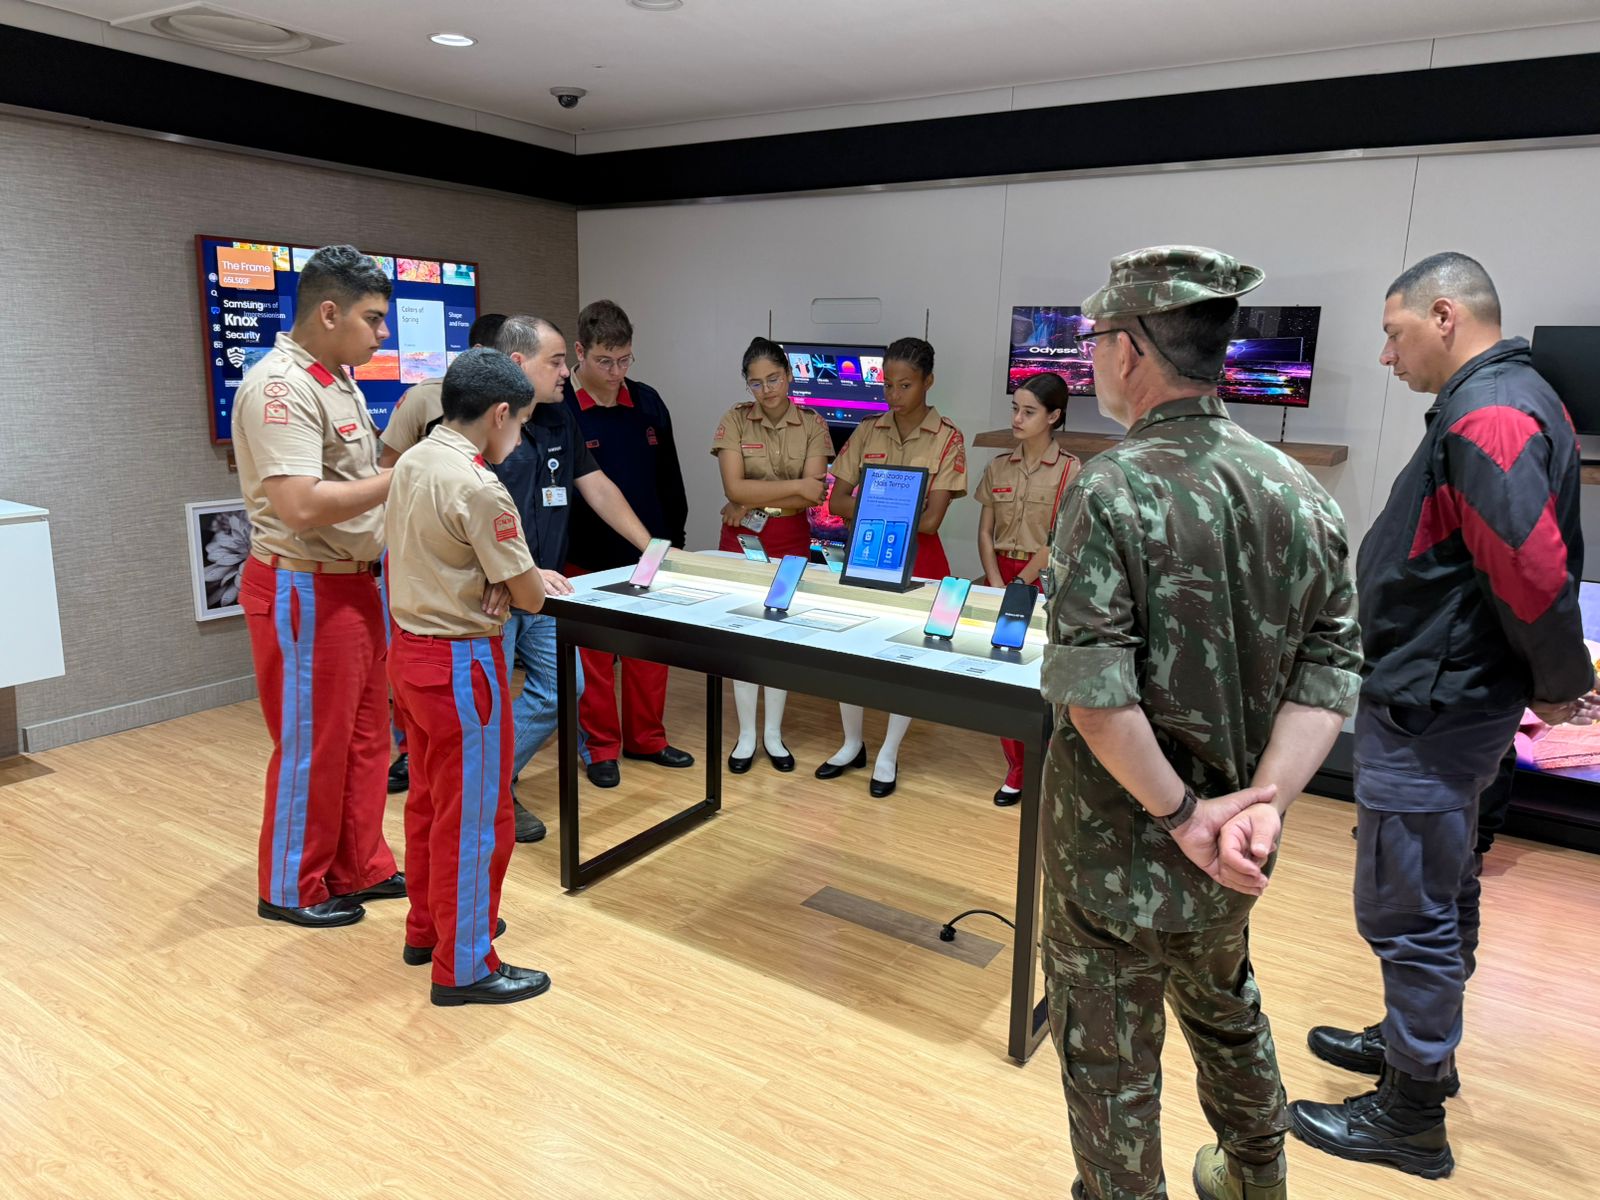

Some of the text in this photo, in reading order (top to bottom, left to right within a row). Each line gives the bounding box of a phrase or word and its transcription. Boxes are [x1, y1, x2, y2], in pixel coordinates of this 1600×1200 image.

[222, 261, 271, 273] The Frame
[223, 299, 264, 312] Samsung
[224, 313, 259, 327] Knox
[402, 316, 419, 324] Spring
[225, 330, 261, 342] Security
[1029, 346, 1079, 356] Odysse
[889, 481, 911, 489] Tempo
